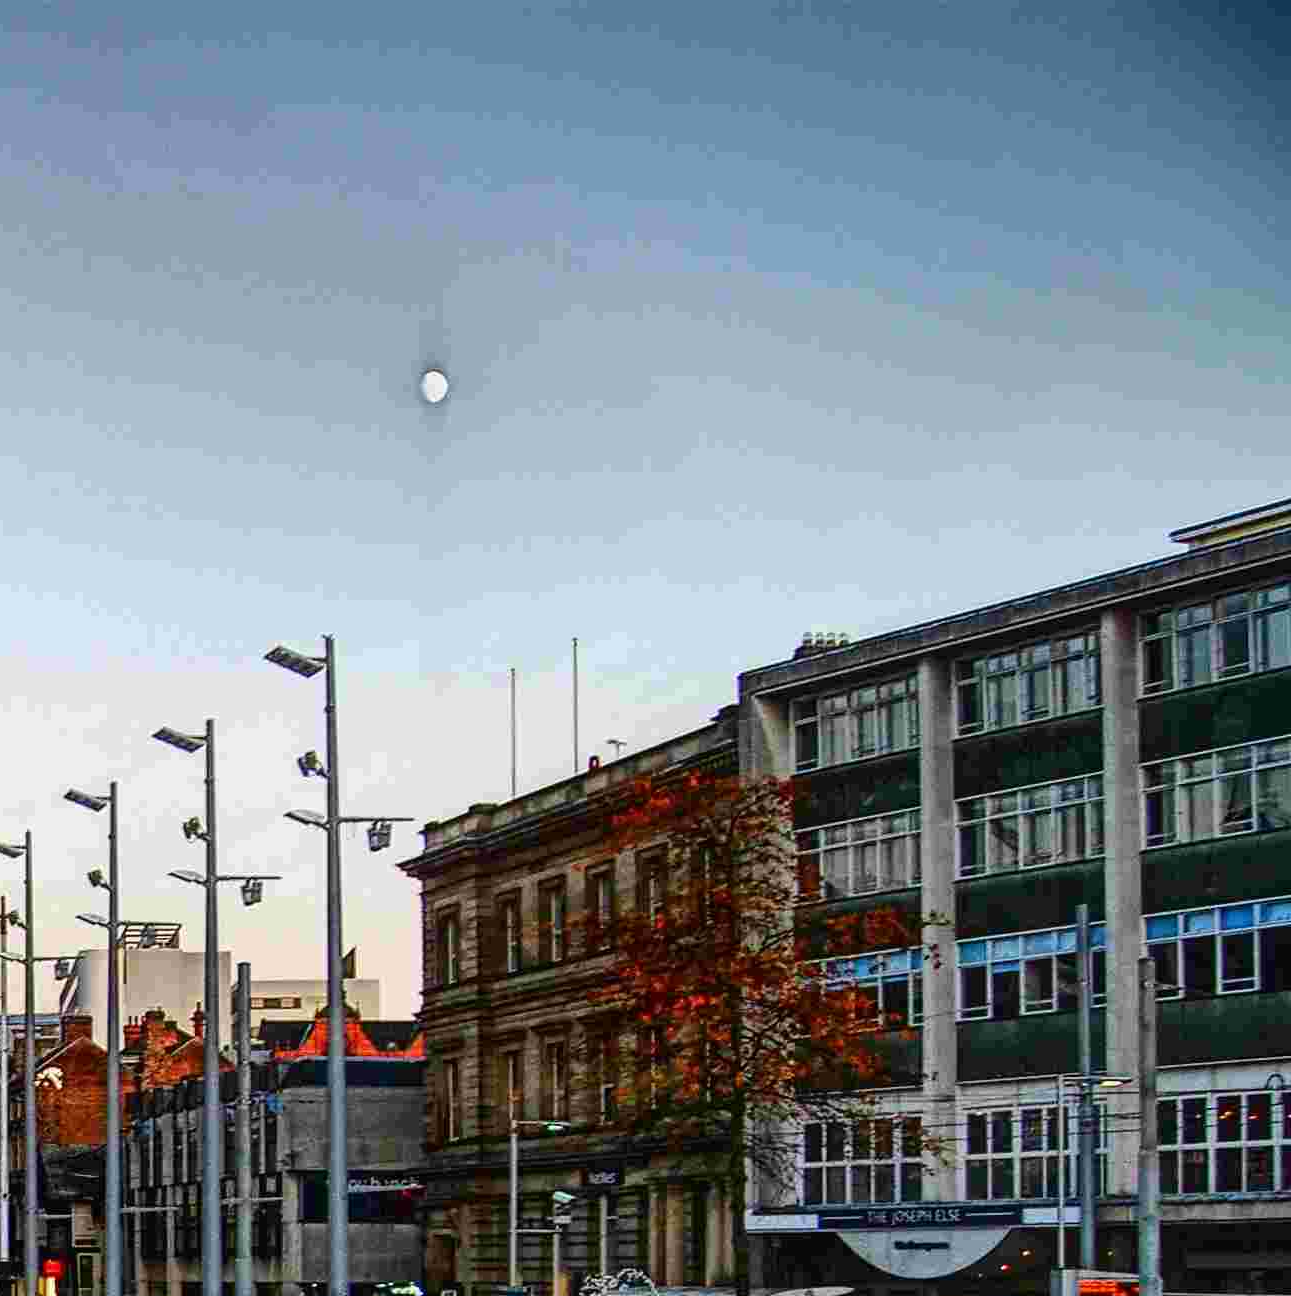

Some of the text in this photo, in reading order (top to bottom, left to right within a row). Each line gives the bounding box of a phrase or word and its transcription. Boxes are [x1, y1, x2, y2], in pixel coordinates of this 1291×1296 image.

[867, 1209, 962, 1225] THE JOSEPH ELSE
